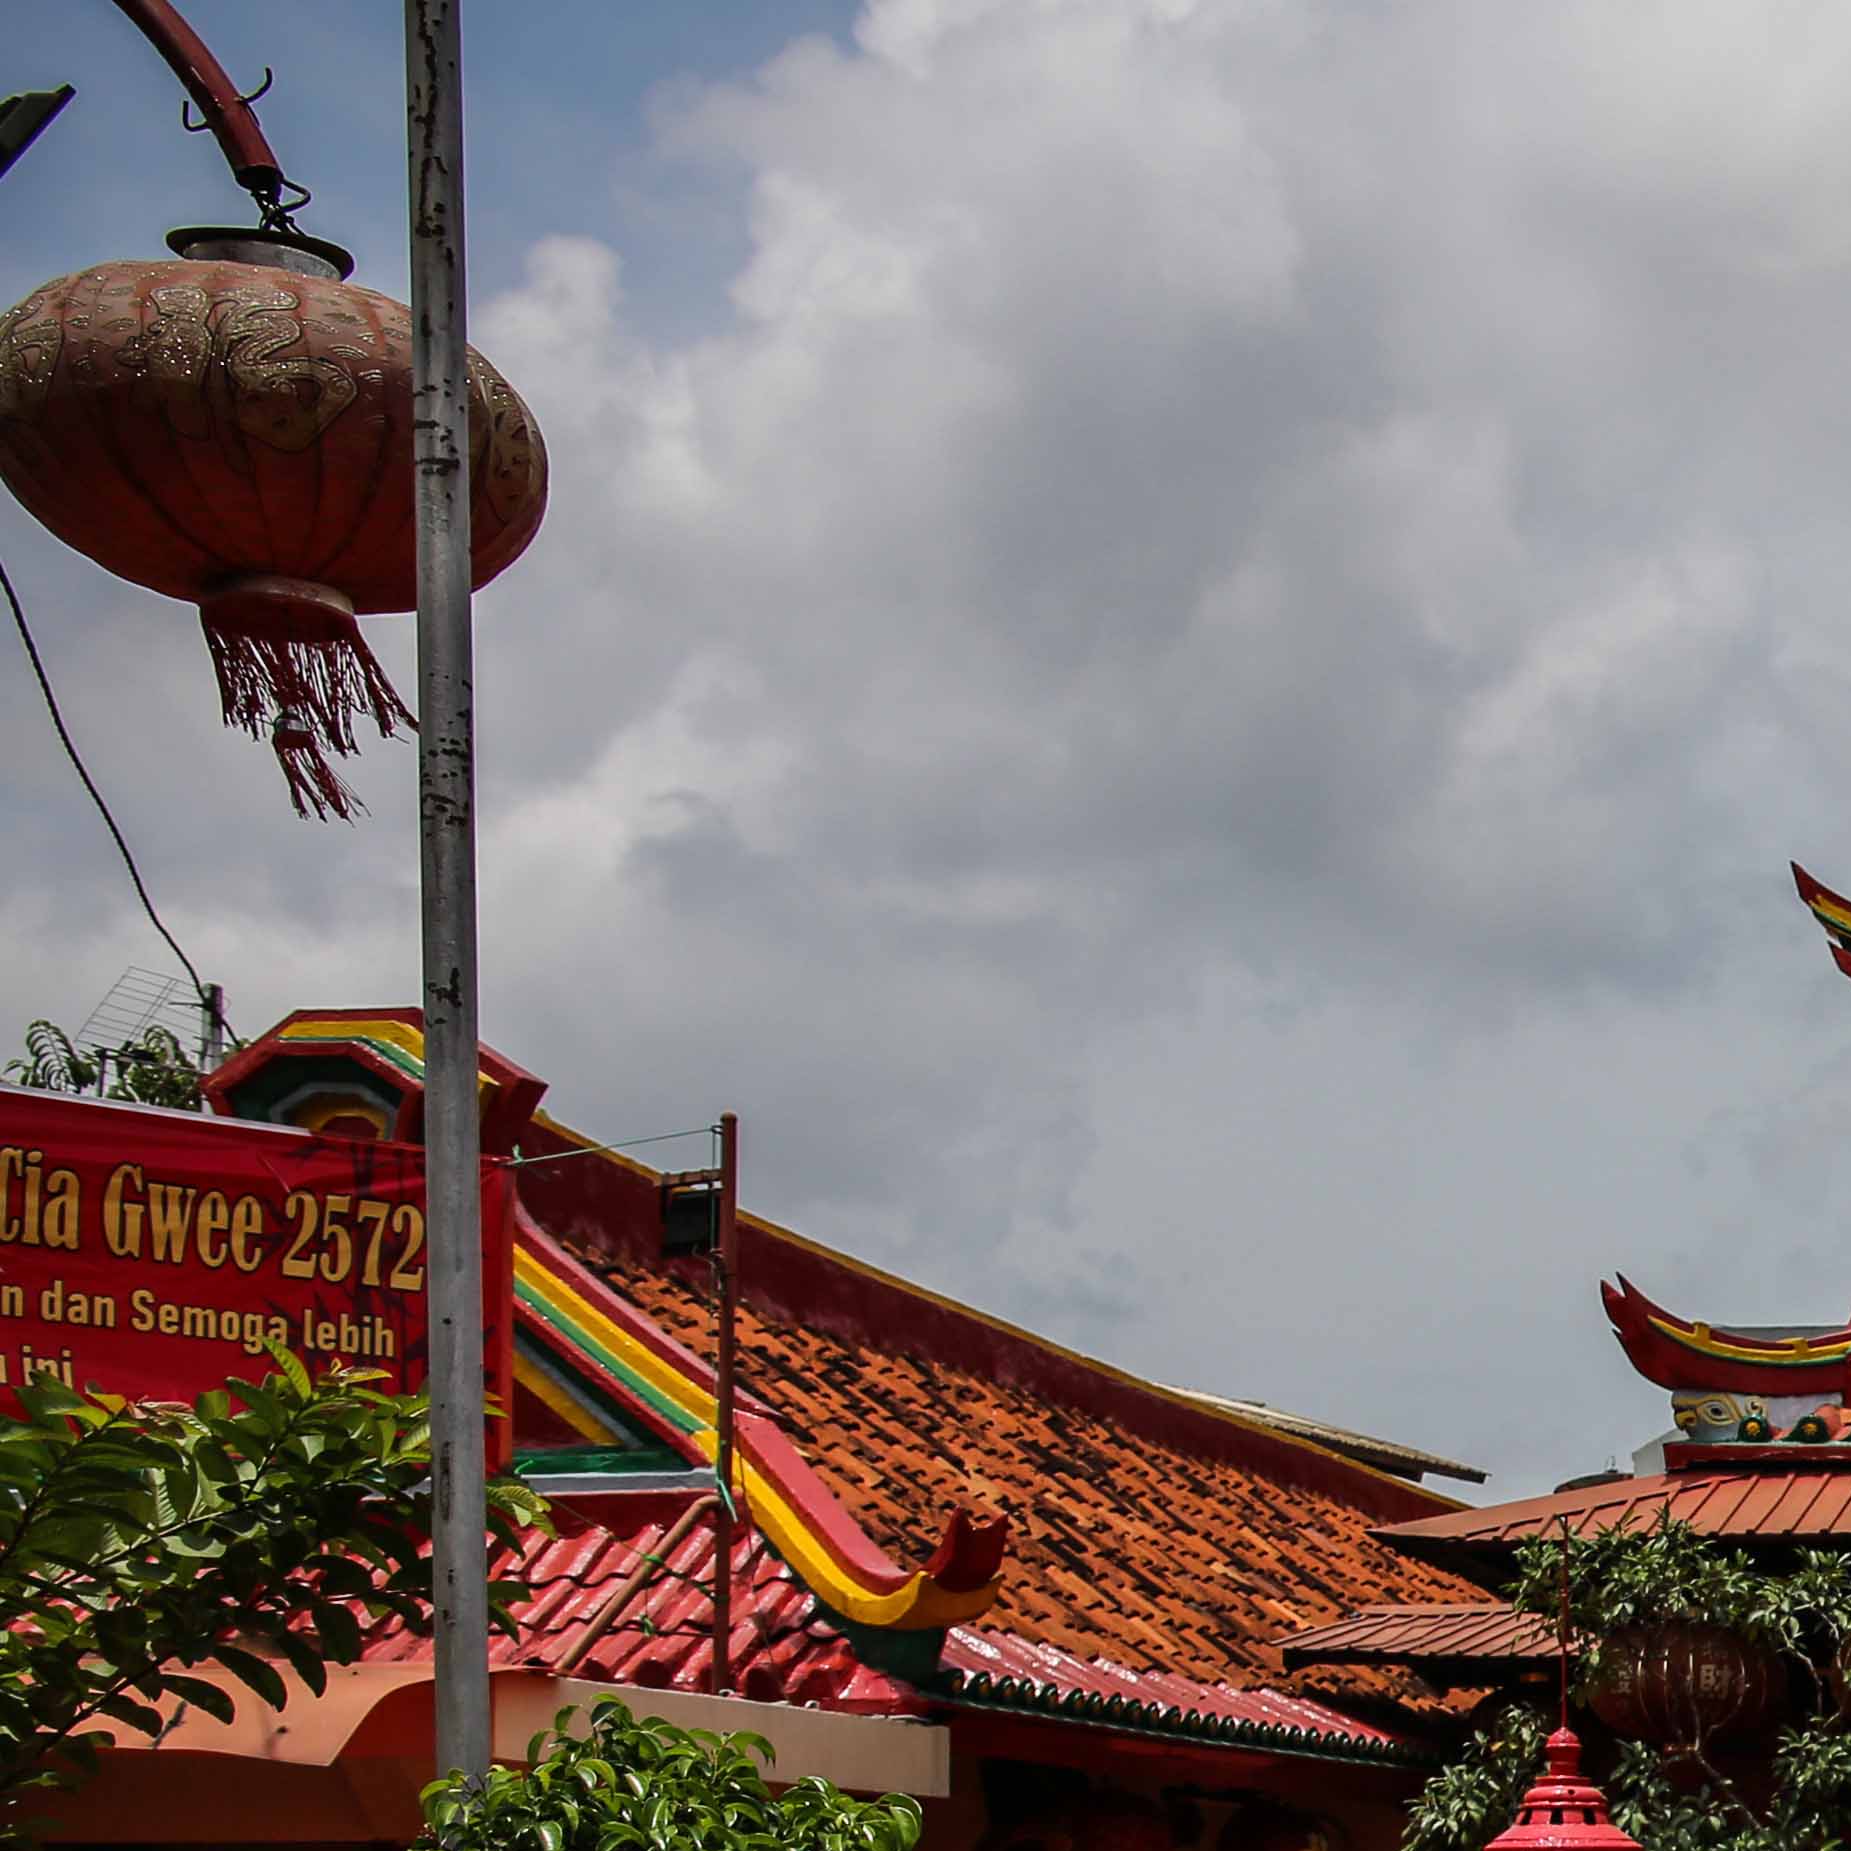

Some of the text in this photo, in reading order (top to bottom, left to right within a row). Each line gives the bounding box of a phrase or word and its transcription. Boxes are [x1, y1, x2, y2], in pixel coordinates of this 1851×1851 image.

[102, 1162, 265, 1272] Gwee
[281, 1188, 426, 1291] 2572
[40, 1279, 117, 1328] dan
[130, 1289, 290, 1354] Semoga
[303, 1308, 396, 1358] lebih
